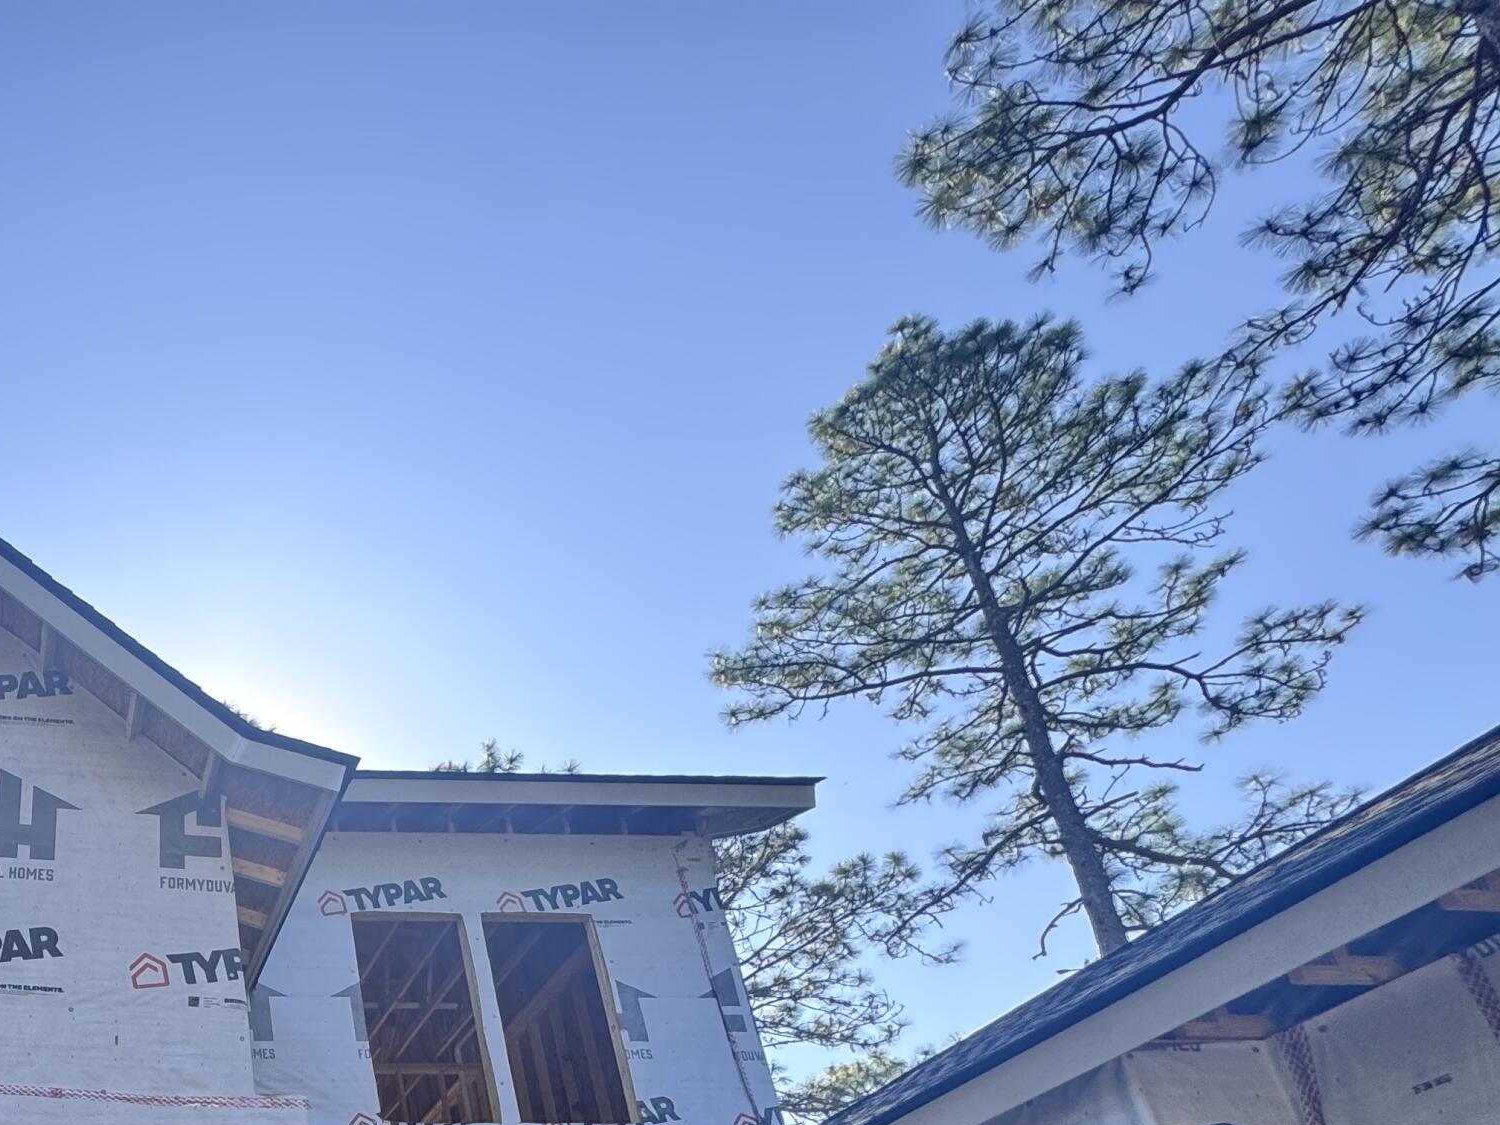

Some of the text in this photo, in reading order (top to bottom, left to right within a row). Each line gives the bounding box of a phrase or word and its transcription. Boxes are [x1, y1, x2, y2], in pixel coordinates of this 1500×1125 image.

[8, 867, 54, 881] HOMES
[159, 876, 235, 893] FORMYDUV
[342, 876, 447, 911] TYPAR
[521, 878, 625, 912] TYPAR
[166, 948, 245, 984] TYP
